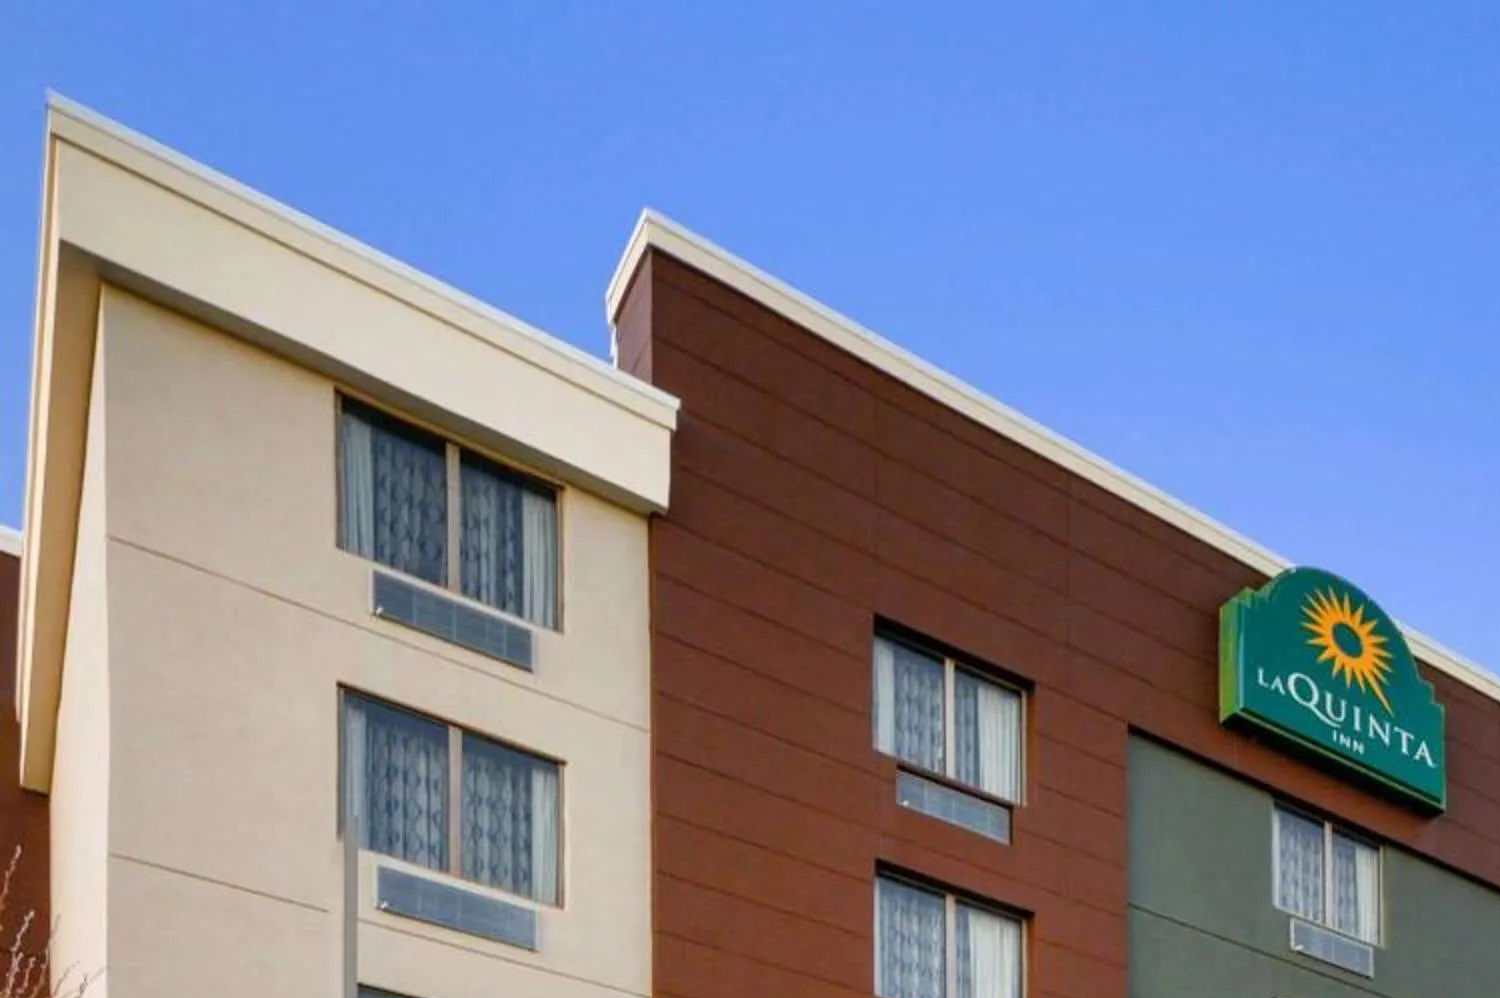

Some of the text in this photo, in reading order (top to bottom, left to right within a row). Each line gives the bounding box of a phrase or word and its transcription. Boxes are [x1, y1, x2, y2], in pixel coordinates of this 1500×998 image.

[1257, 666, 1437, 769] LA QUINTA
[1332, 729, 1365, 755] INN
